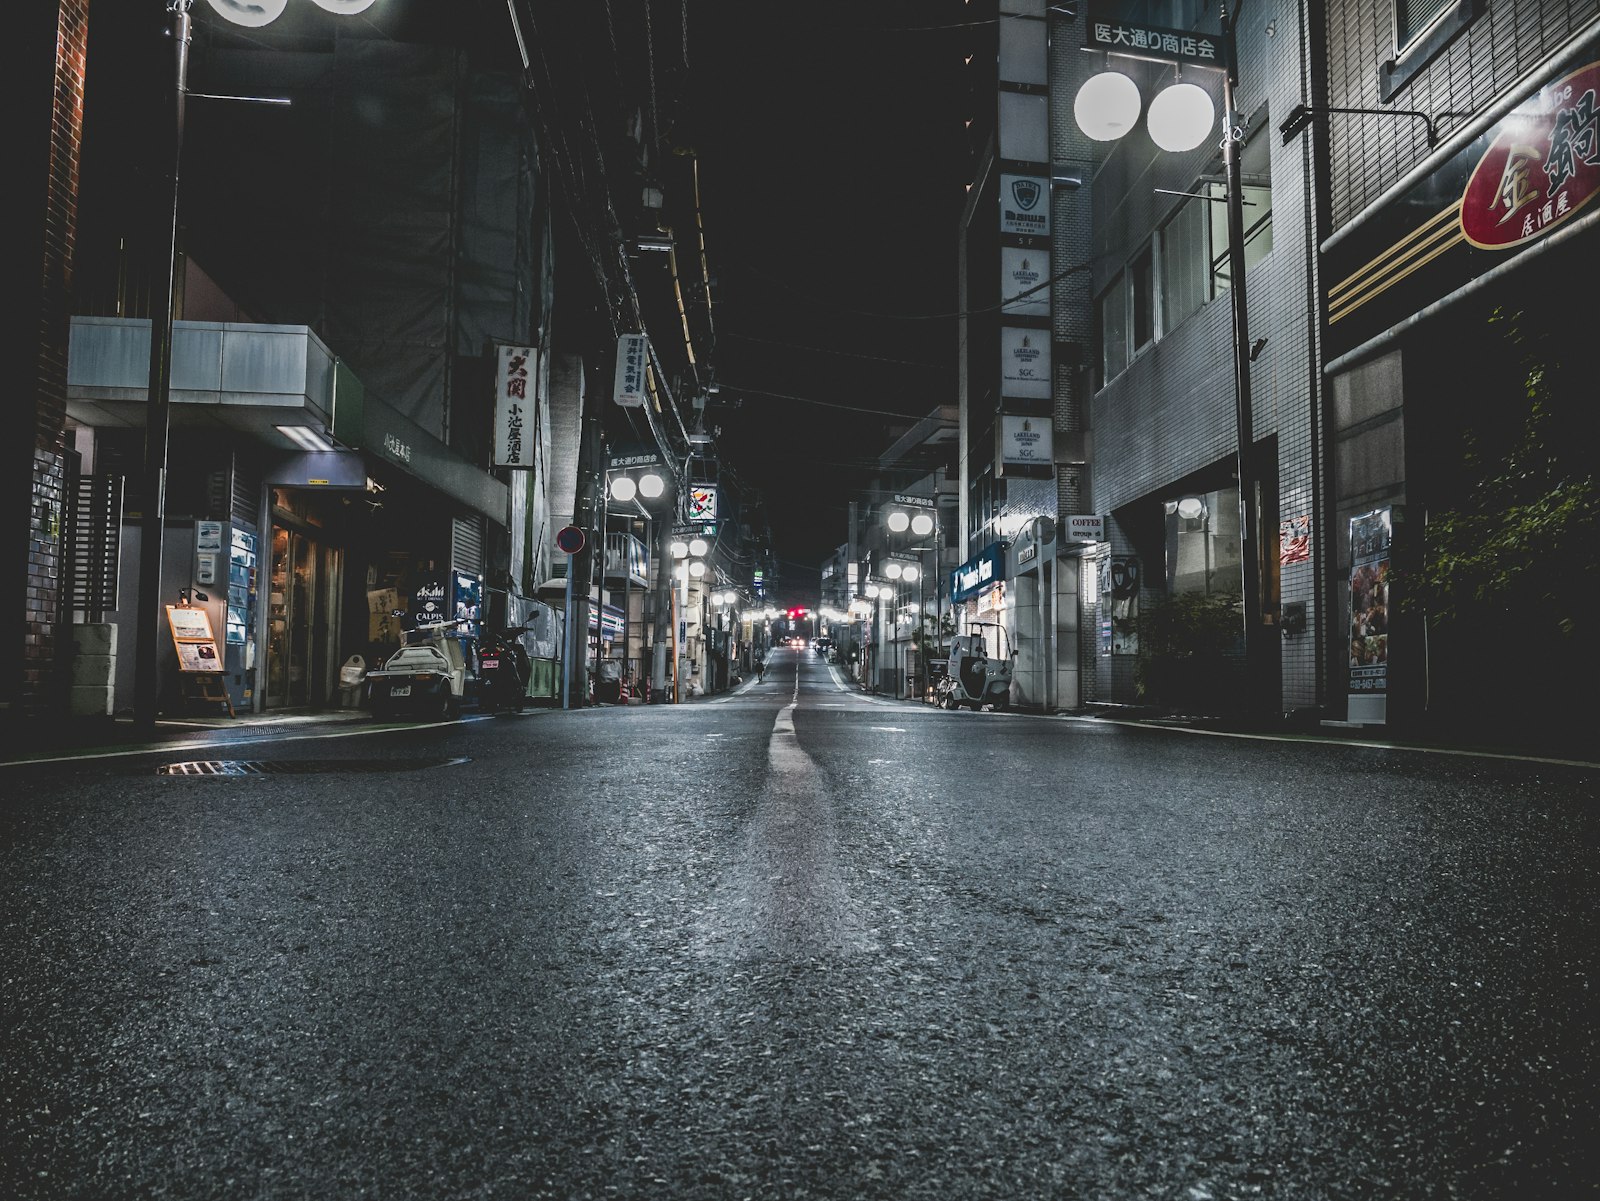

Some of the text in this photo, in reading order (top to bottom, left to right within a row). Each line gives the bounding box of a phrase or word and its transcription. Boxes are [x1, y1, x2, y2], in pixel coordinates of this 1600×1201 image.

[1094, 23, 1215, 60] 医大通り商店会
[1521, 190, 1572, 237] 居酒屋
[1019, 369, 1034, 377] SGC
[506, 404, 523, 464] 小池屋酒店
[1019, 449, 1034, 458] SGC
[611, 454, 658, 467] 医大通り商店会
[1072, 519, 1102, 527] COFFEE
[417, 582, 445, 597] Asahi
[416, 612, 445, 621] CALPIS
